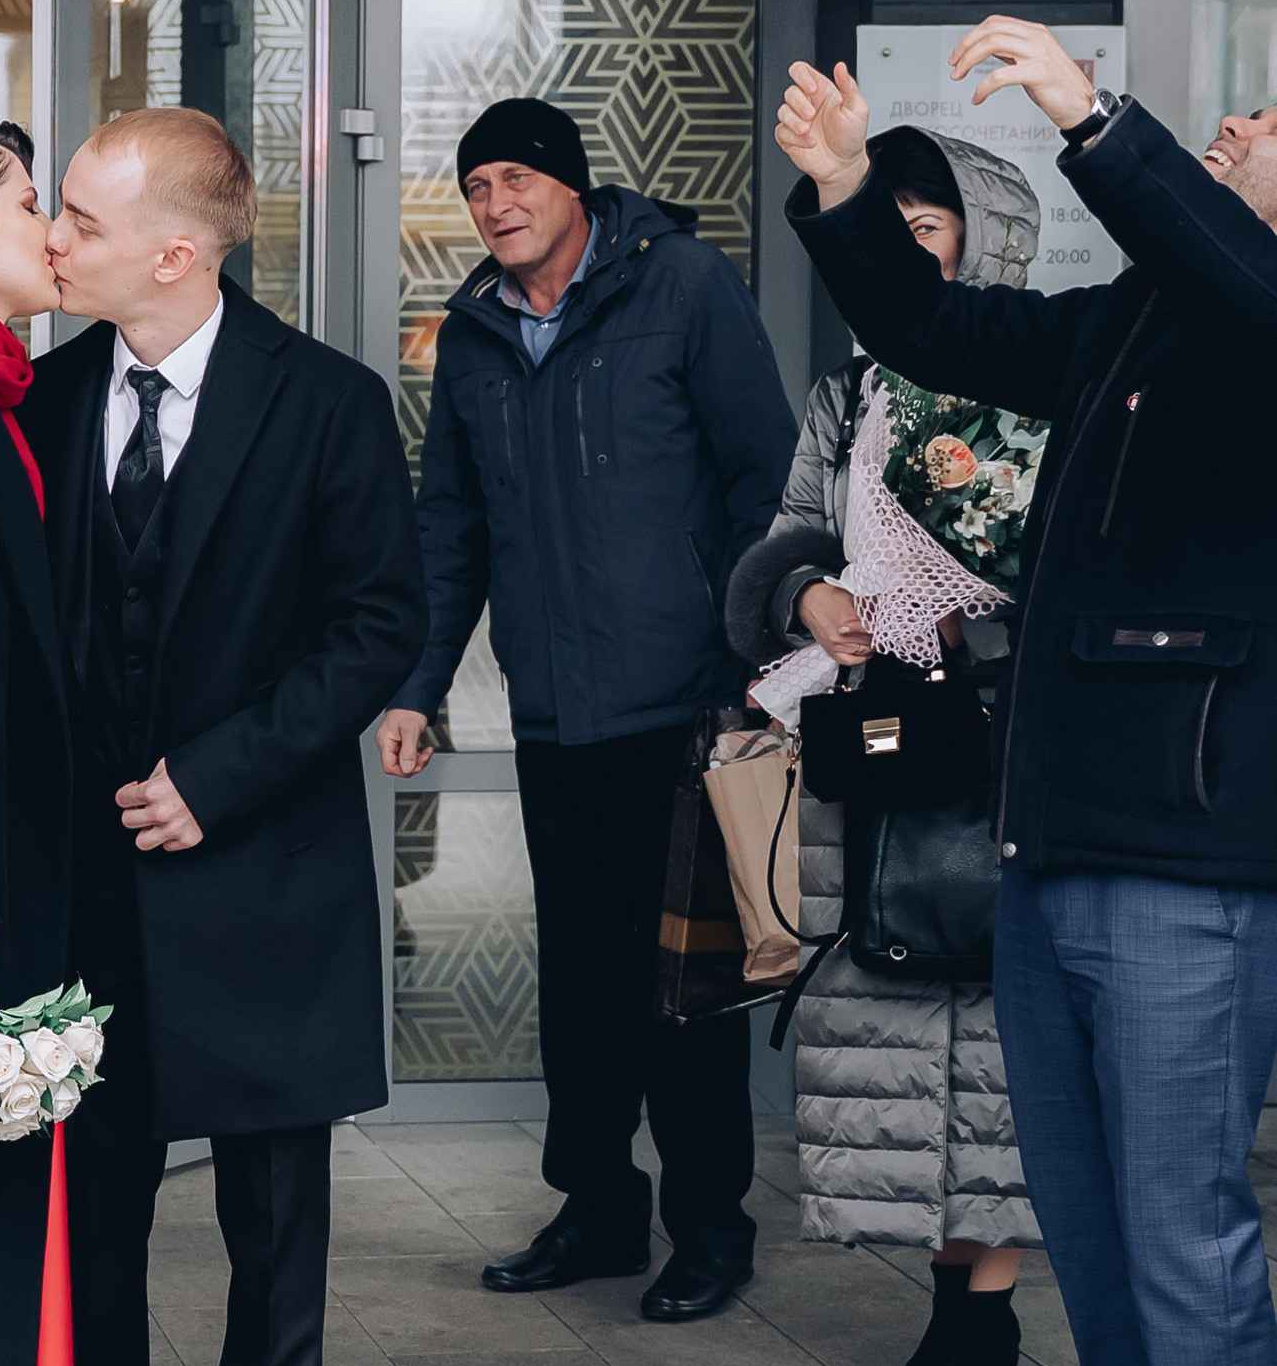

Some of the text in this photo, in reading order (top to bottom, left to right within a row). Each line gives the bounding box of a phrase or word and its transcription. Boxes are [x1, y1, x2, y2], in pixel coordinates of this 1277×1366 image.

[889, 101, 963, 119] ДВОРЕЦ
[929, 124, 1057, 141] ОСОЧЕТАНИЯ
[1049, 207, 1092, 223] 18:00
[1045, 248, 1091, 264] 20:00
